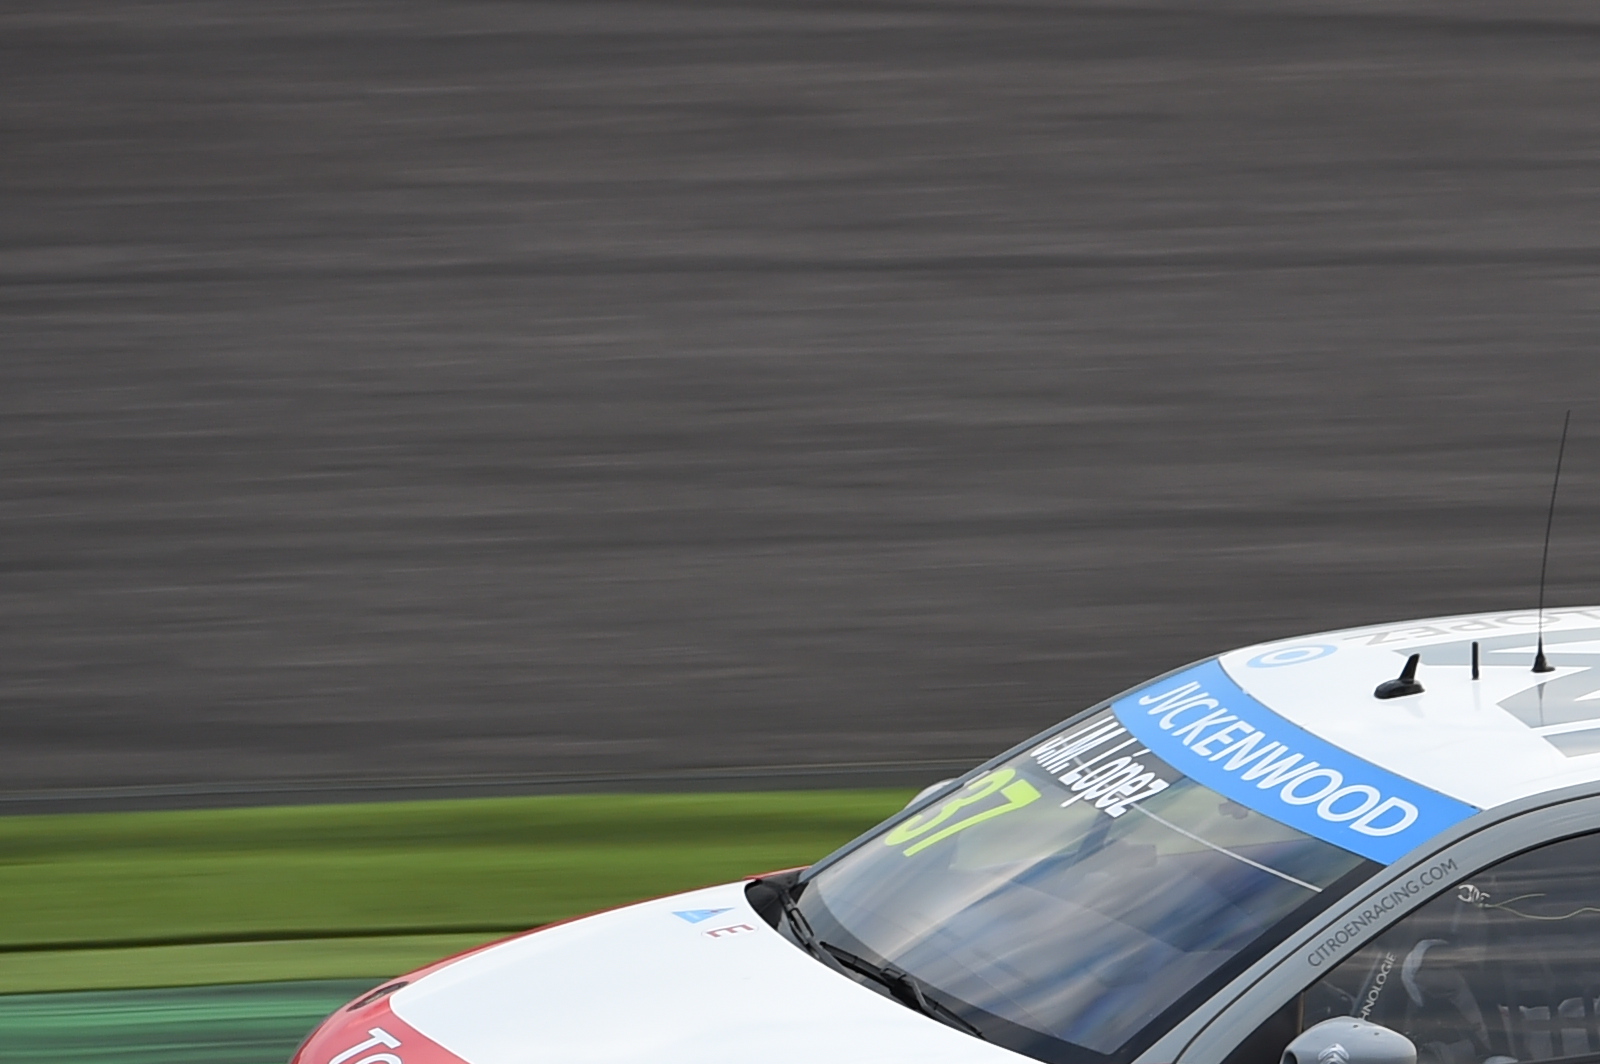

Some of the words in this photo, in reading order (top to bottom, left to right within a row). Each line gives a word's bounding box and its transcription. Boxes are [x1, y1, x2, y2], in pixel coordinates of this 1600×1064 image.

[884, 768, 1041, 857] 37
[1058, 738, 1170, 819] López
[706, 924, 754, 938] E
[1307, 858, 1459, 967] CITROENRACING.COM
